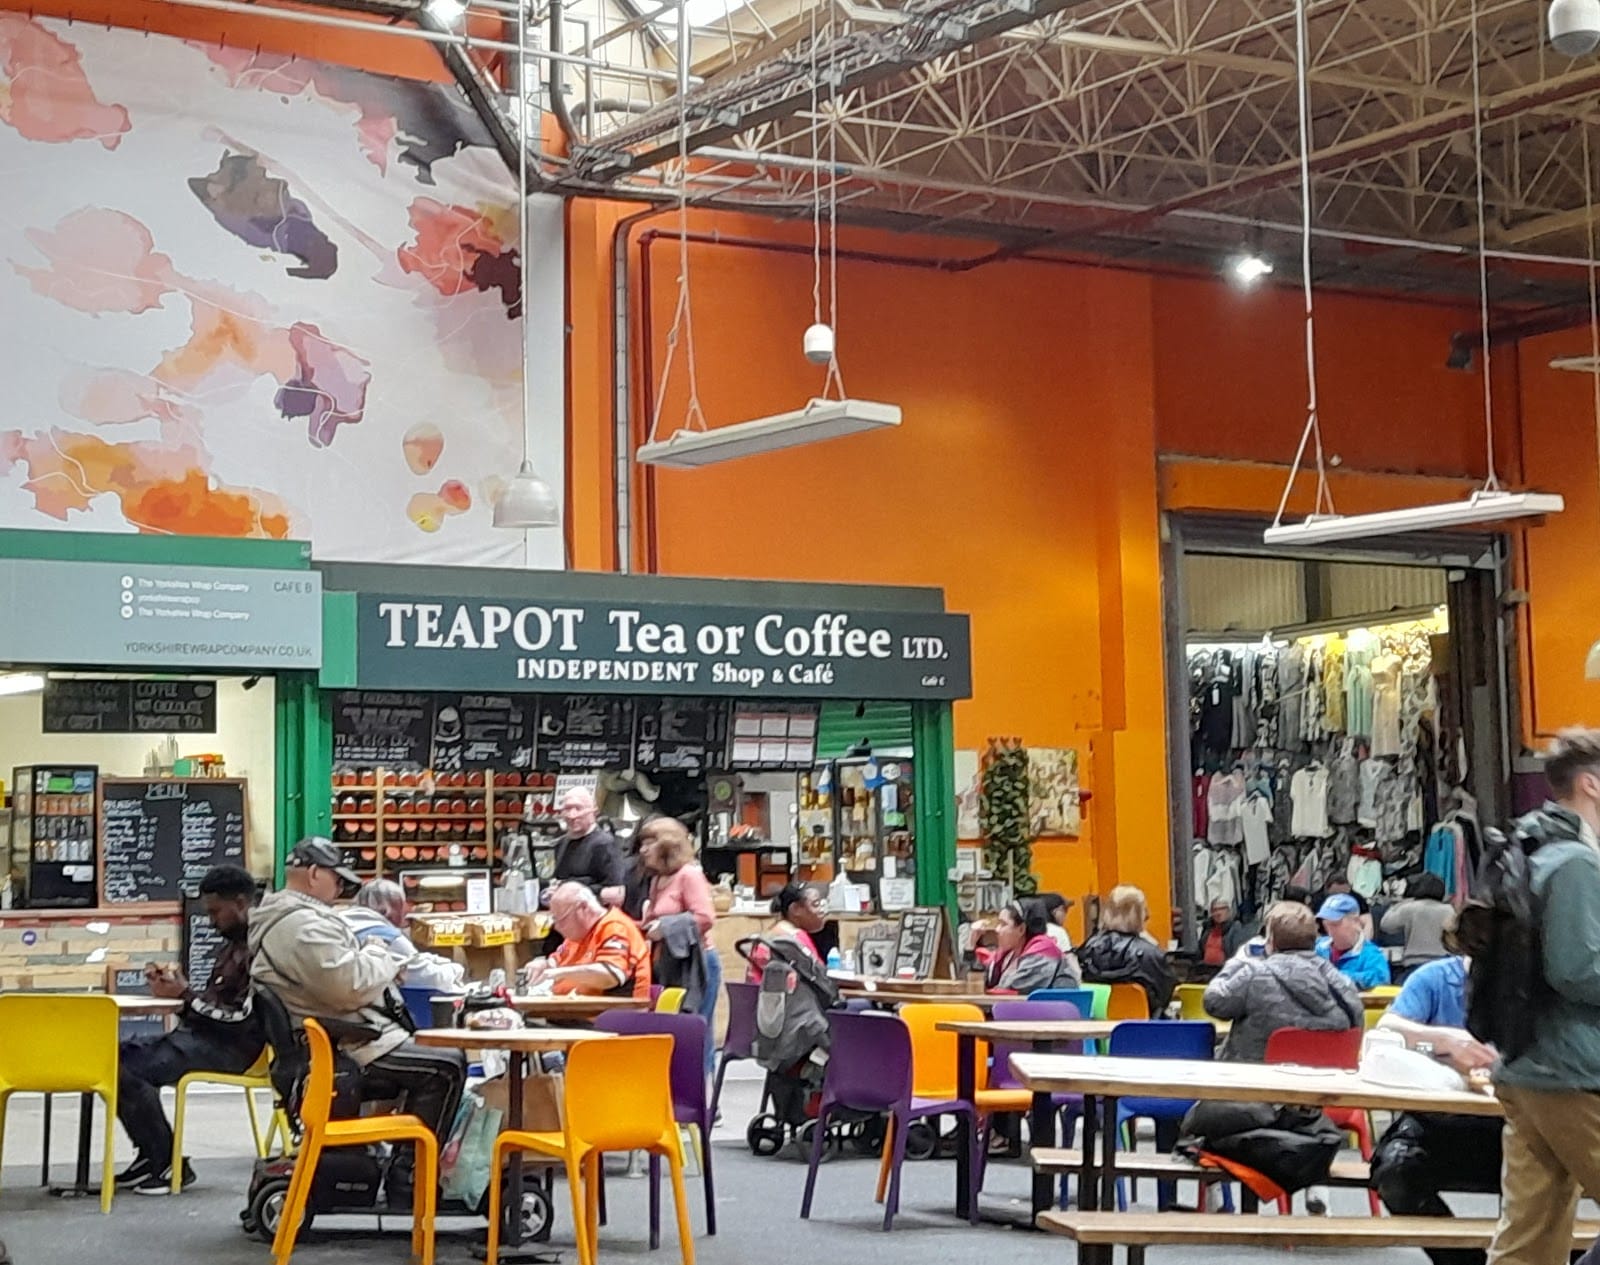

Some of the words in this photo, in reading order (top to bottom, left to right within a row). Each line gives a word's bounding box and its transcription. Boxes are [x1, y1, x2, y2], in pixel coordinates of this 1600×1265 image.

[274, 581, 302, 593] CAFE
[379, 603, 584, 650] TEAPOT
[608, 610, 687, 654] Tea
[696, 623, 744, 655] or
[755, 613, 891, 659] Coffee
[902, 637, 949, 659] LTD.
[516, 658, 698, 682] INDEPENDENT
[712, 661, 764, 688] Shop
[772, 669, 784, 684] &
[788, 662, 834, 685] Café
